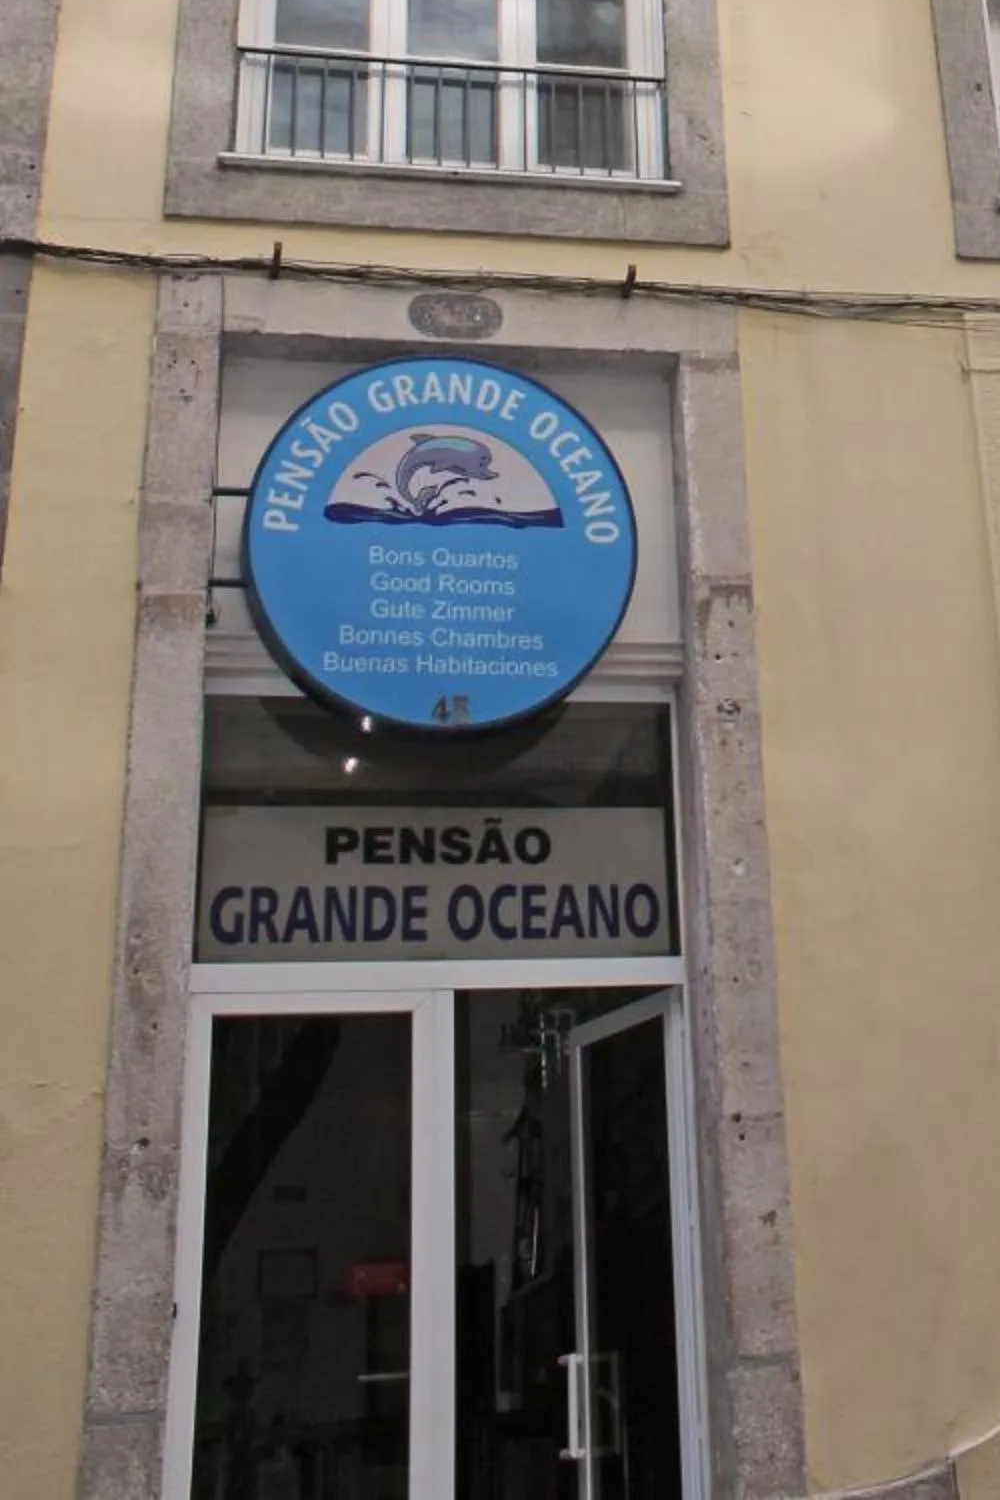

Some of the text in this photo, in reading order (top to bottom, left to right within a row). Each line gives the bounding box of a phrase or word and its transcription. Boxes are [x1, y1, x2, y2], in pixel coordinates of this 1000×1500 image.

[262, 371, 620, 544] PENSÃO GRANDE OCEANO
[368, 545, 519, 570] Bons Quartos
[370, 571, 516, 596] Good Rooms
[370, 598, 514, 621] Gute Zimmer
[338, 625, 544, 651] Bonnes Chambres
[323, 652, 559, 678] Buenas Habitaciones
[324, 817, 551, 866] PENSÃO
[209, 883, 660, 945] GRANDE OCEANO
